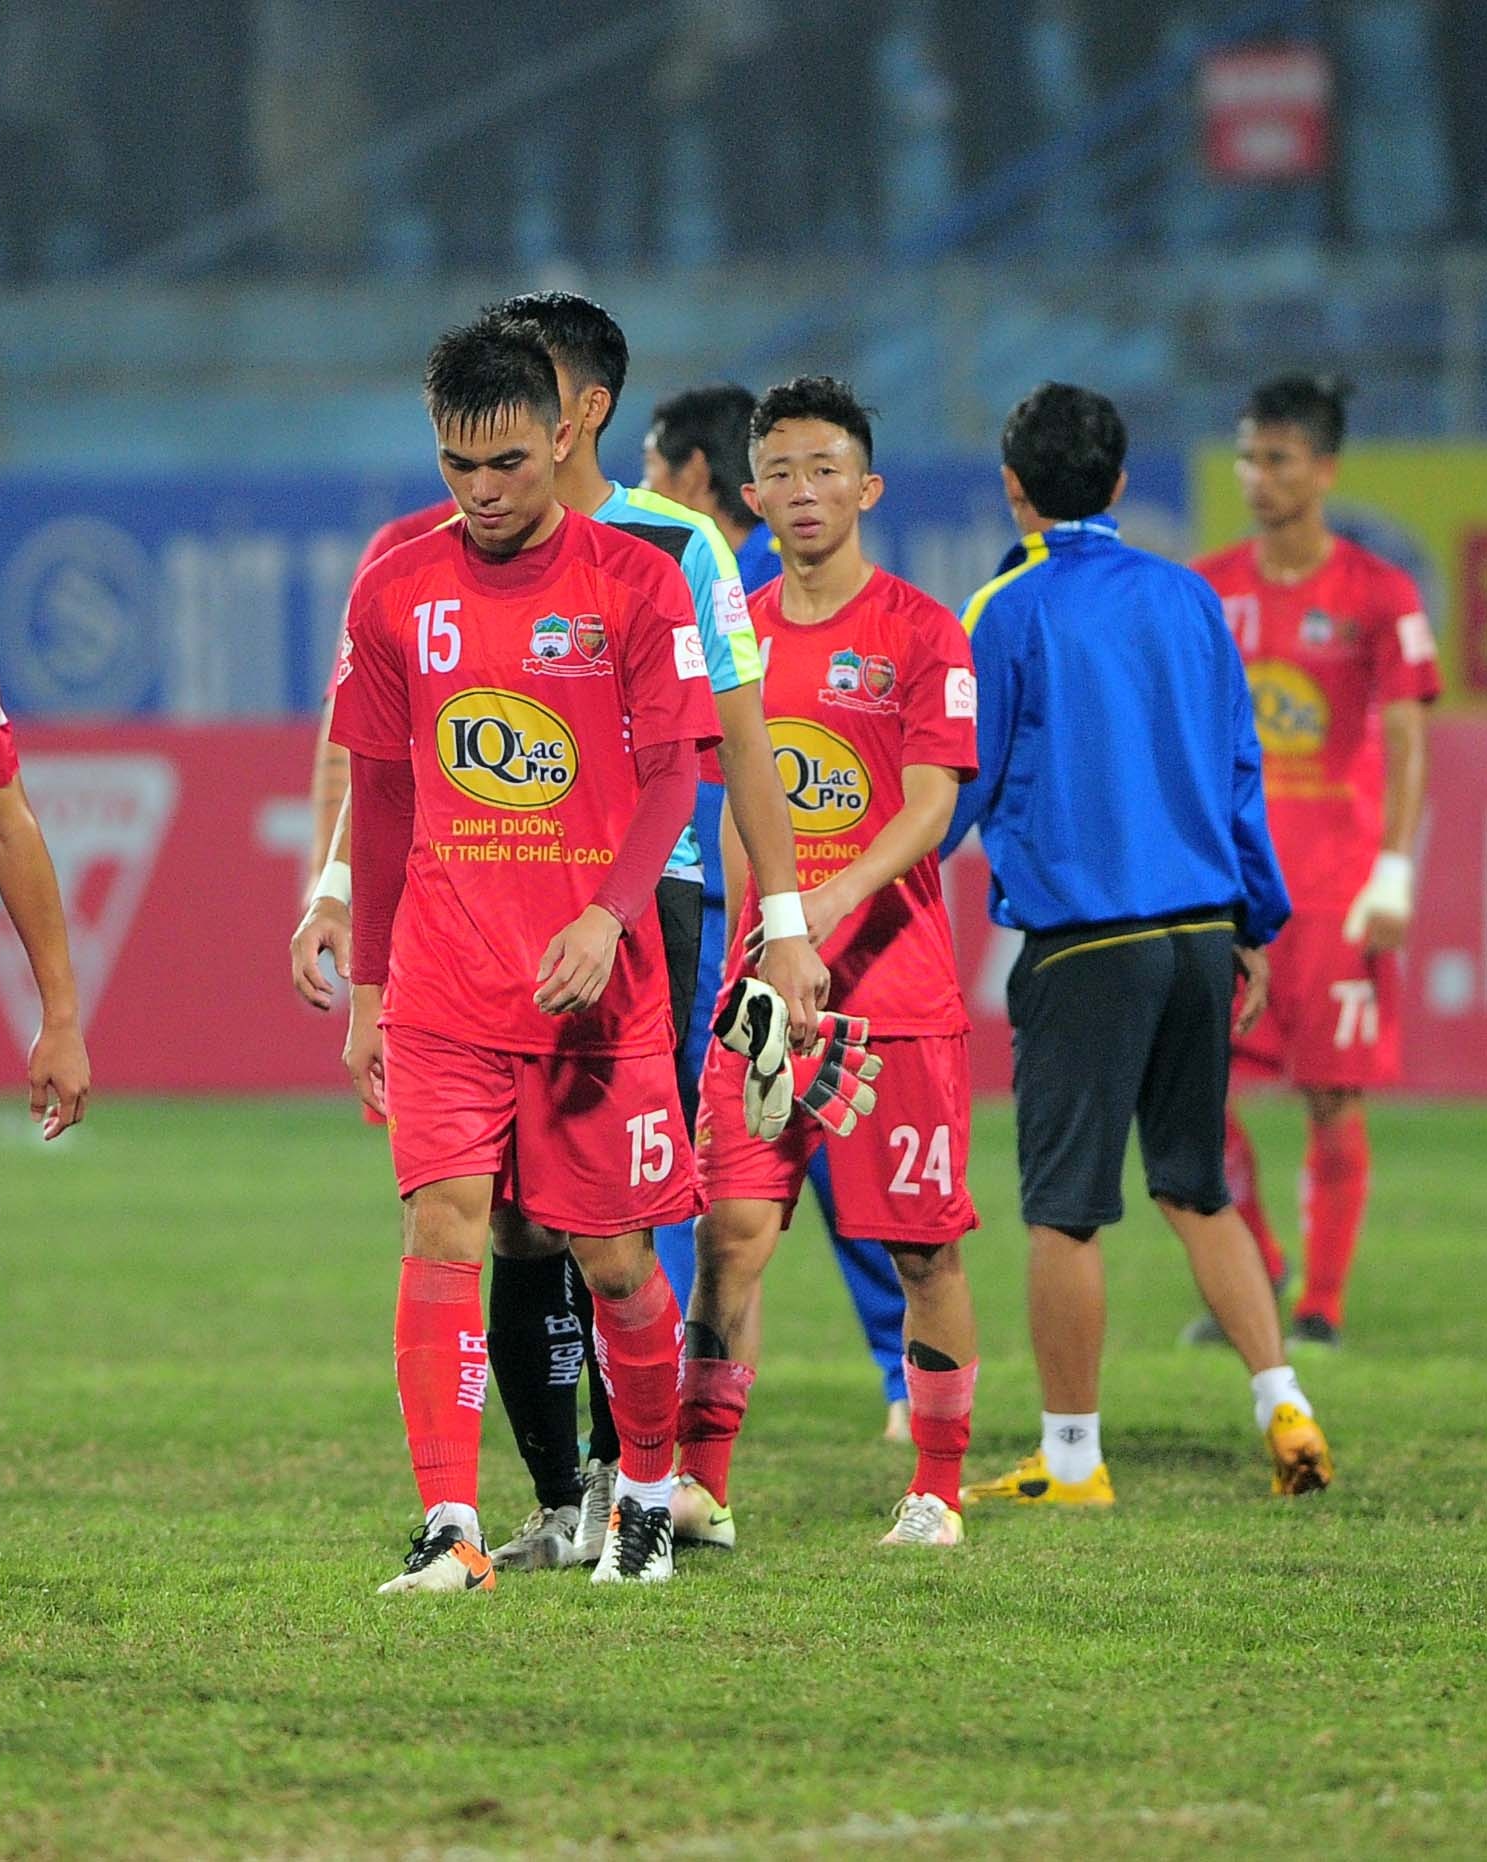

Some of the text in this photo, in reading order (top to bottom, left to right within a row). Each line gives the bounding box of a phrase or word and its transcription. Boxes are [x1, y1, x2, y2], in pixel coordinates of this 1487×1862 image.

[414, 599, 461, 675] 15
[449, 717, 564, 784] IQ Lac
[525, 760, 568, 784] Pro
[773, 747, 857, 810] Q Lac
[452, 818, 497, 836] DINH
[818, 788, 862, 809] Pro
[456, 838, 512, 862] TRIỂN
[575, 848, 614, 865] CAO
[625, 1108, 674, 1188] 15
[887, 1124, 952, 1197] 24
